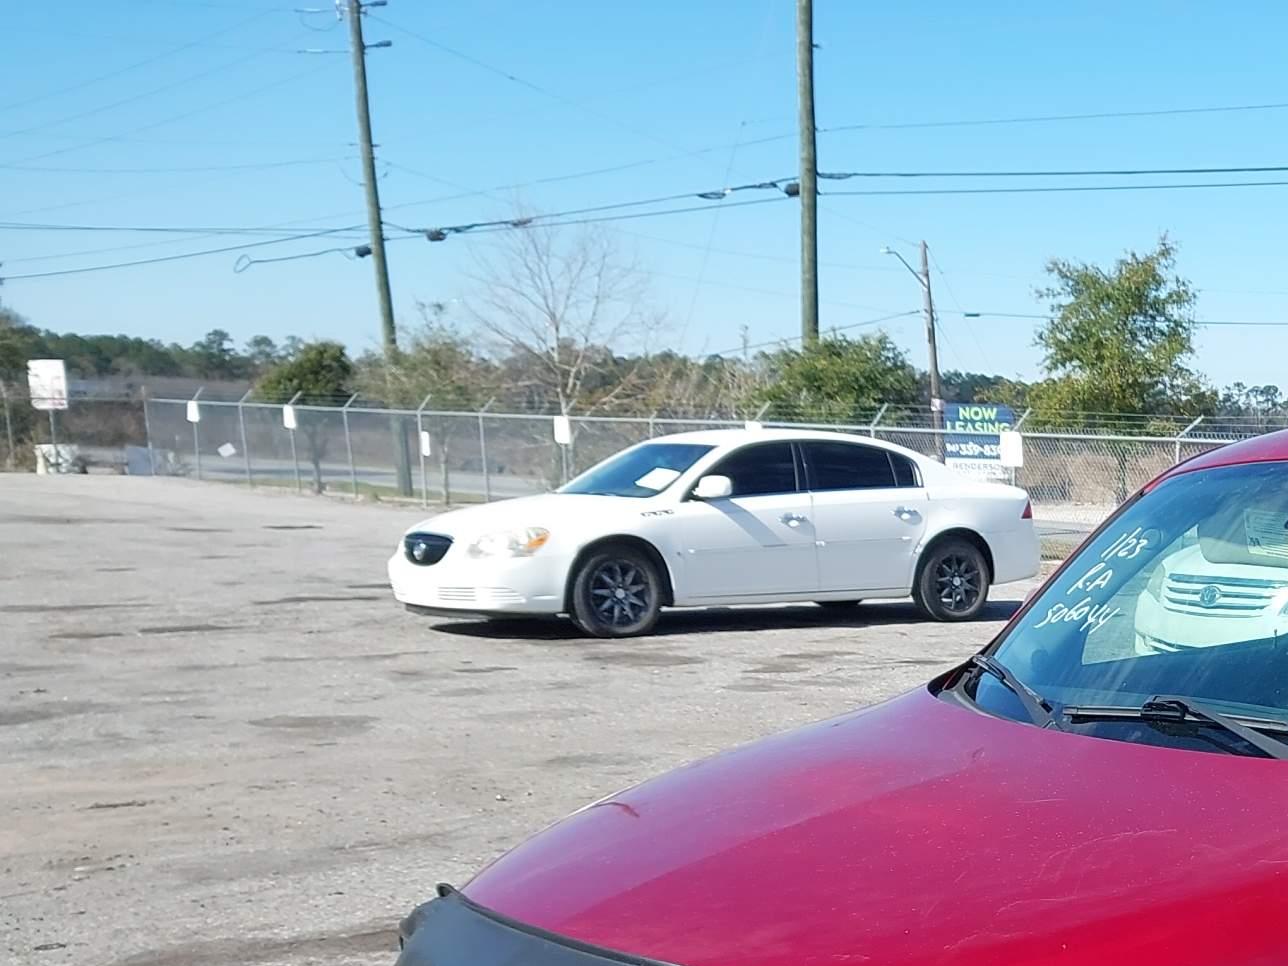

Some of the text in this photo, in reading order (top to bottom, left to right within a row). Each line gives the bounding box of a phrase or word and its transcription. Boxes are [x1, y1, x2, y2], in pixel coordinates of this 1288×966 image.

[958, 406, 997, 421] NOW
[946, 421, 1010, 433] LEASING
[1100, 526, 1148, 559] 1/23
